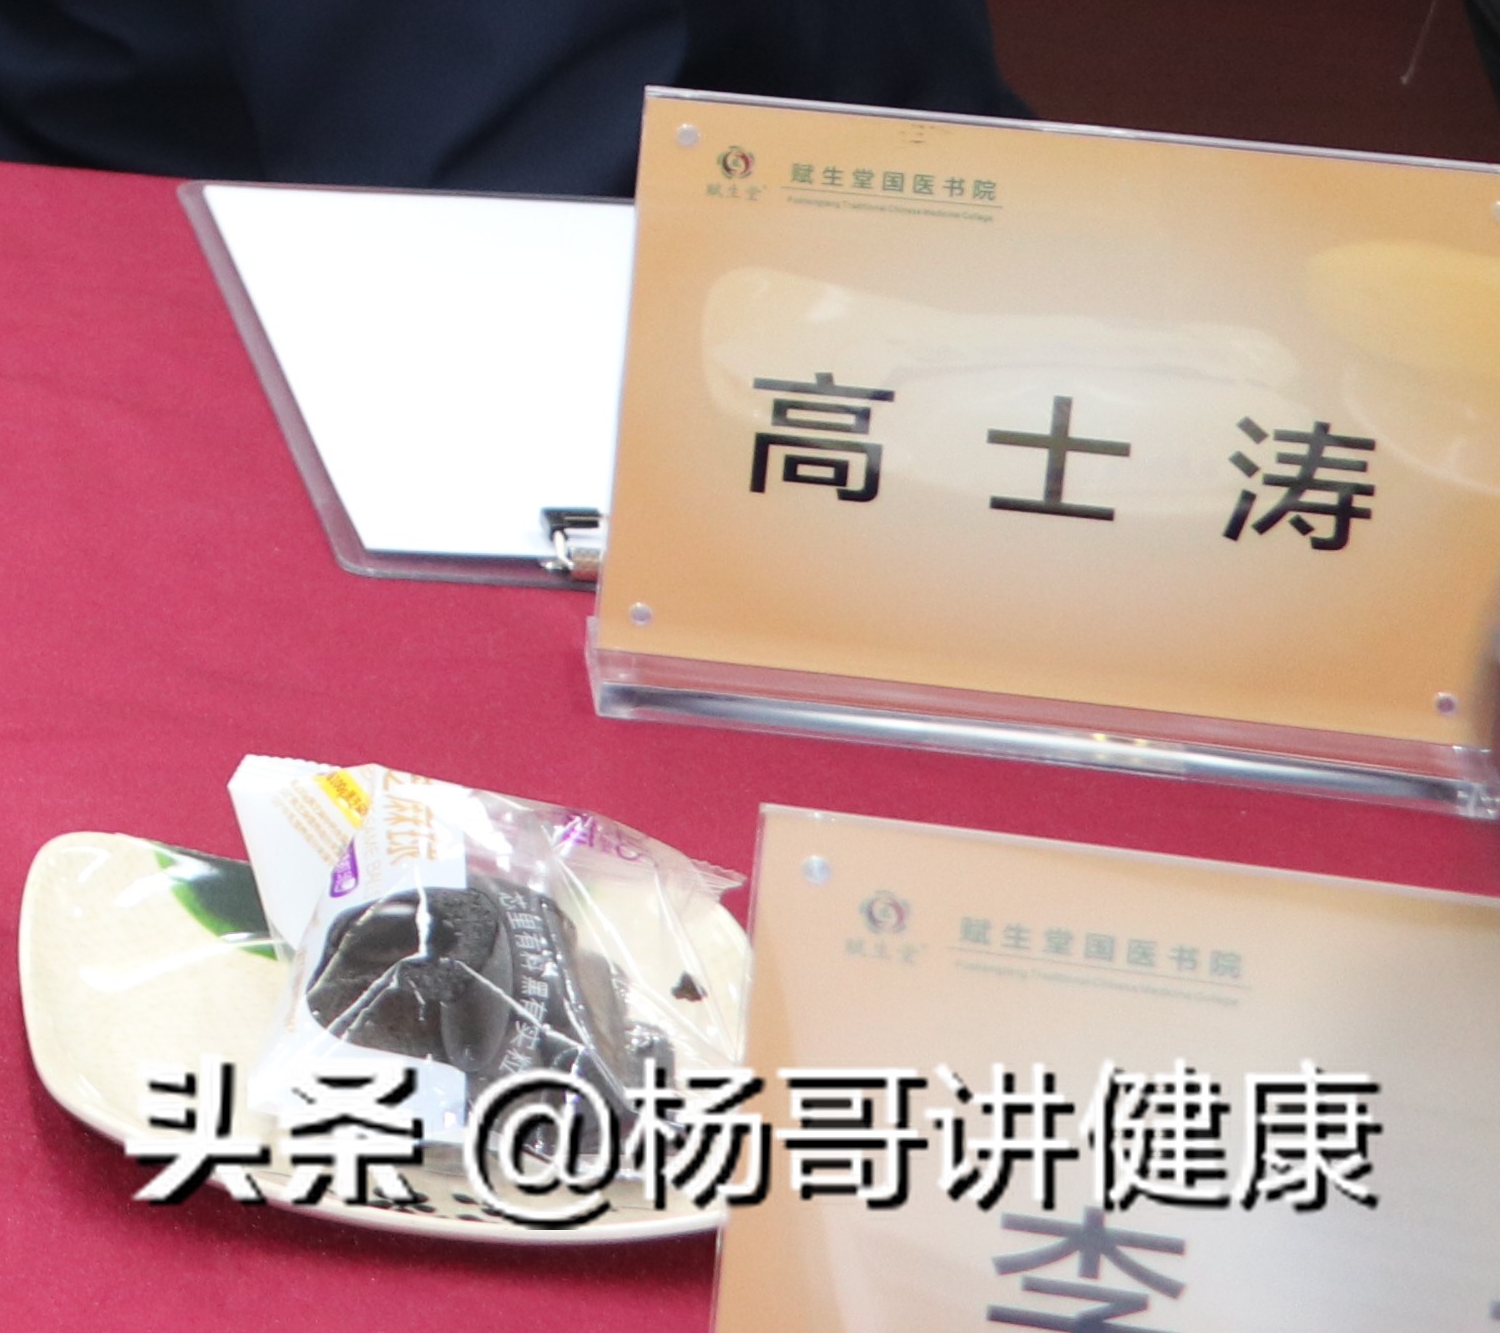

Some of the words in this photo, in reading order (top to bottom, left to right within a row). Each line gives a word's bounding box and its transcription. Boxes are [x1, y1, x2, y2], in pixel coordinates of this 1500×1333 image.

[791, 163, 997, 201] 赋生堂国医书院
[749, 373, 1377, 552] 高士涛
